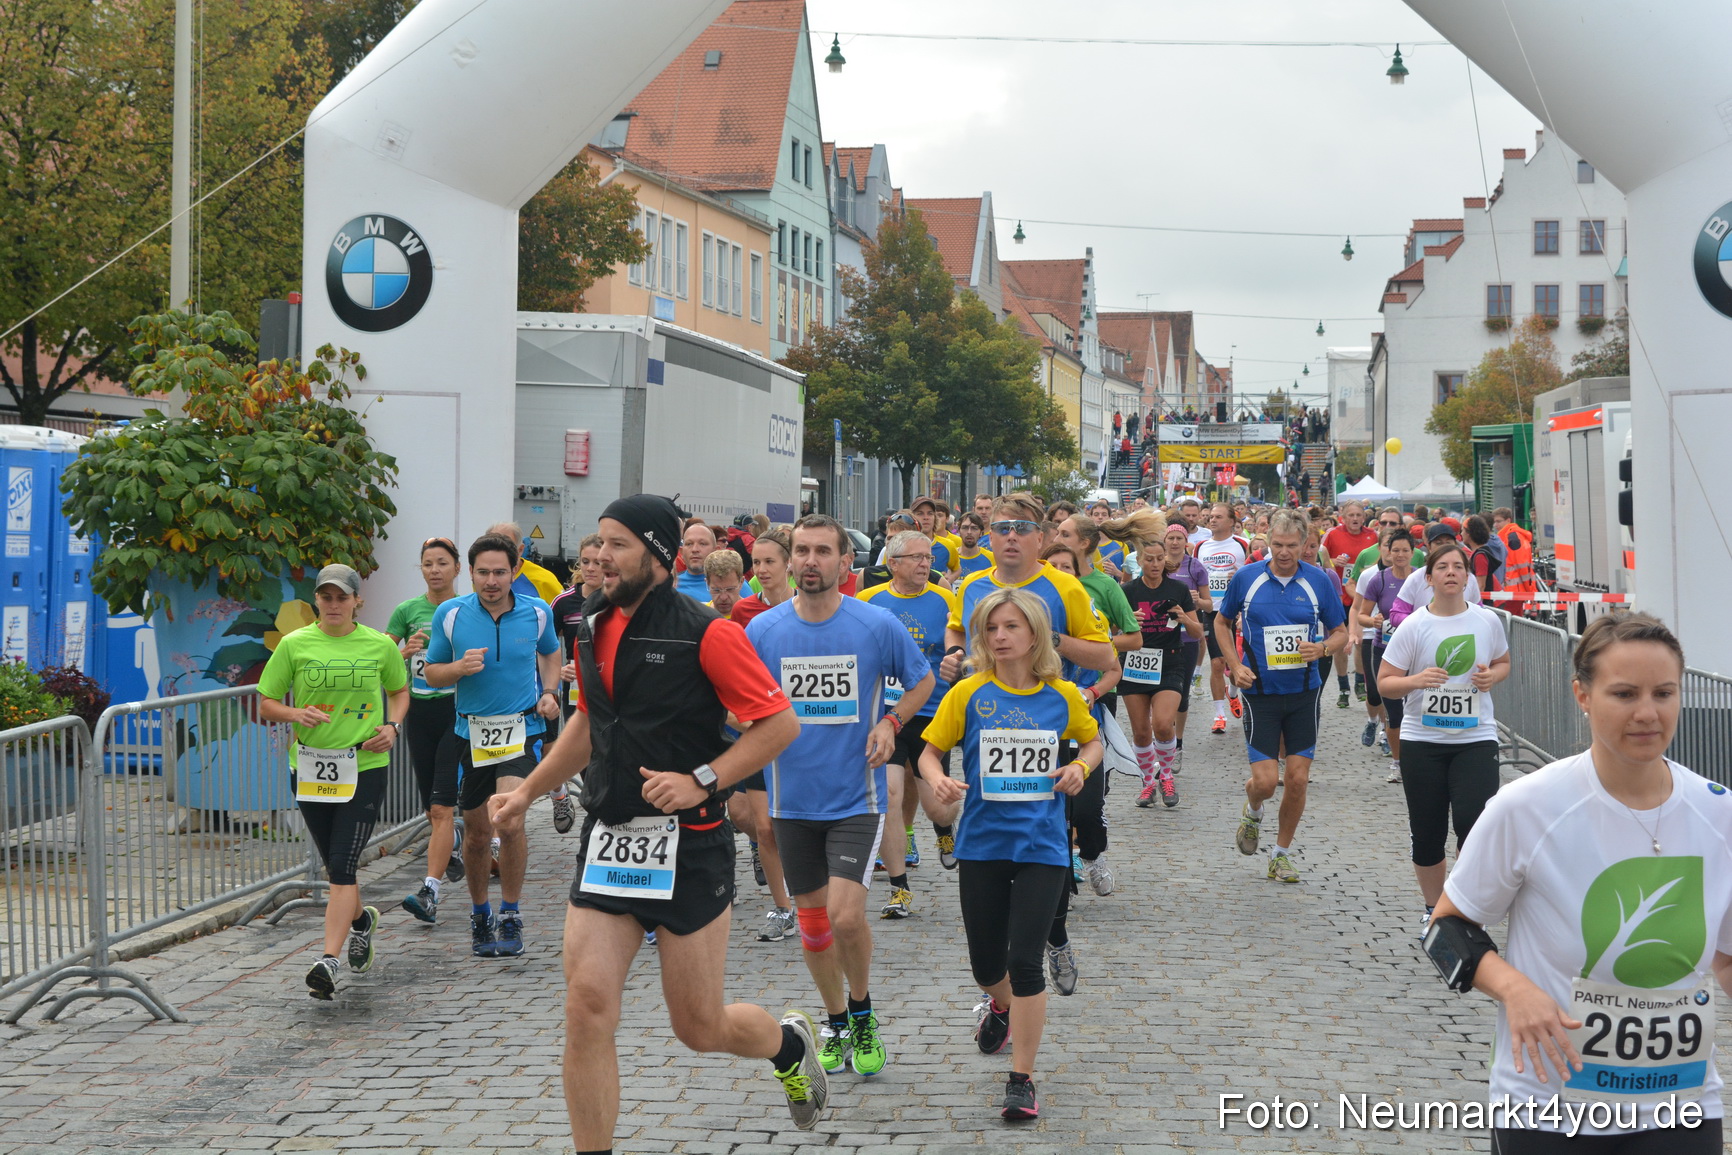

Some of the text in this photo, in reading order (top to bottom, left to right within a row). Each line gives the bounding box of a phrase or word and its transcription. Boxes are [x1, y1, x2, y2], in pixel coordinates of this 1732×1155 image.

[333, 217, 424, 255] BMW
[768, 414, 797, 457] BOCK
[1200, 448, 1242, 458] START
[646, 652, 665, 660] GORE
[1128, 654, 1159, 671] 3392
[808, 662, 844, 670] Neumarkt
[789, 672, 851, 698] 2255
[804, 704, 838, 715] Roland
[1427, 695, 1472, 715] 2051
[1436, 719, 1464, 727] Sabrina
[481, 727, 514, 747] 327
[1010, 736, 1046, 744] Neumarkt
[298, 750, 316, 758] PARTL
[989, 747, 1051, 773] 2128
[315, 761, 339, 782] 23
[317, 785, 338, 795] Petra
[1000, 781, 1038, 793] Justyna
[622, 824, 663, 833] Neumarkt
[597, 831, 669, 866] 2834
[606, 870, 652, 886] Michael
[1574, 990, 1624, 1008] PARTL
[1582, 1012, 1703, 1061] 2659
[1596, 1070, 1678, 1090] Christina
